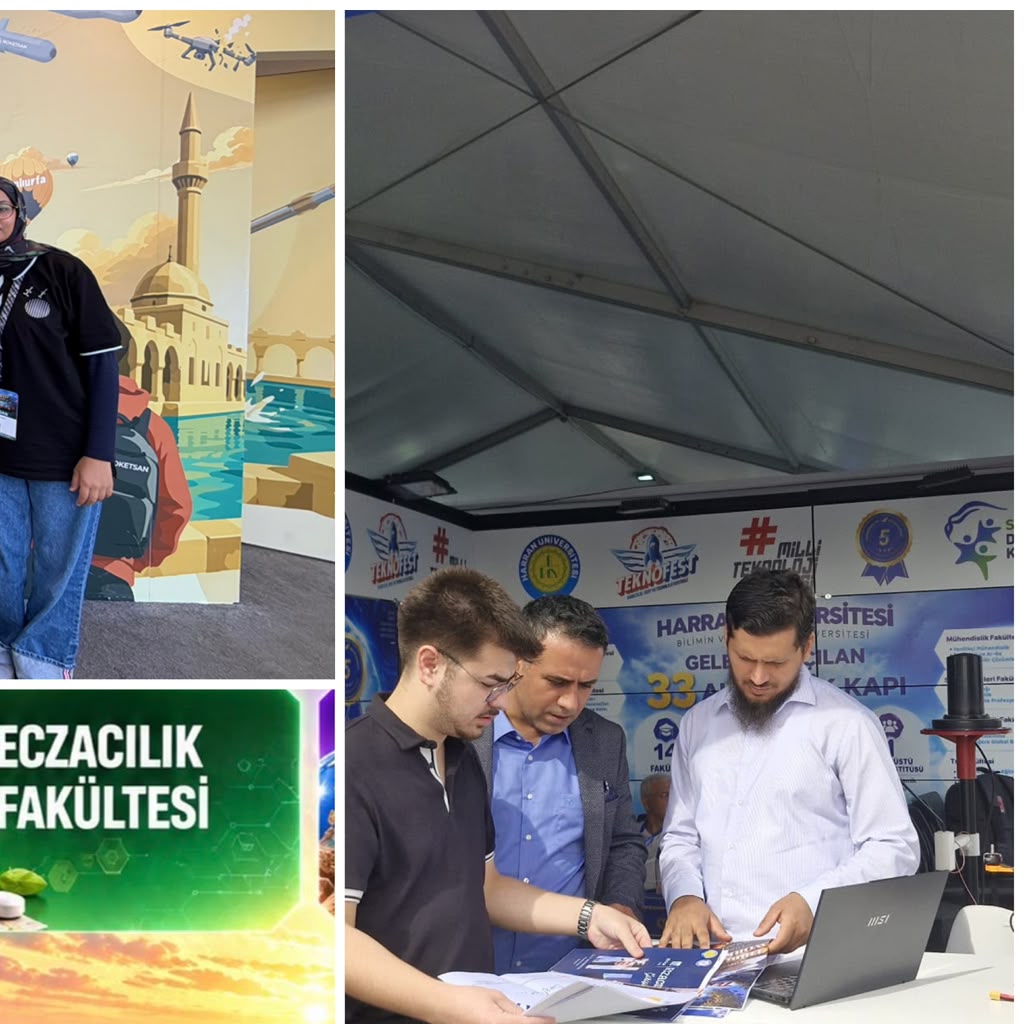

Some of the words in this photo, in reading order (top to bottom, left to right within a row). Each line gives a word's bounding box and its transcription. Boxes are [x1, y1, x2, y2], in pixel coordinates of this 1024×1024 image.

[114, 460, 150, 473] OKETSAN
[370, 552, 419, 585] TEKNOFEST
[616, 553, 700, 596] TEKNOFEST
[815, 601, 895, 627] RSİTESİ
[646, 672, 698, 711] 33
[844, 676, 907, 697] KAPI
[650, 763, 672, 773] FAKÜ
